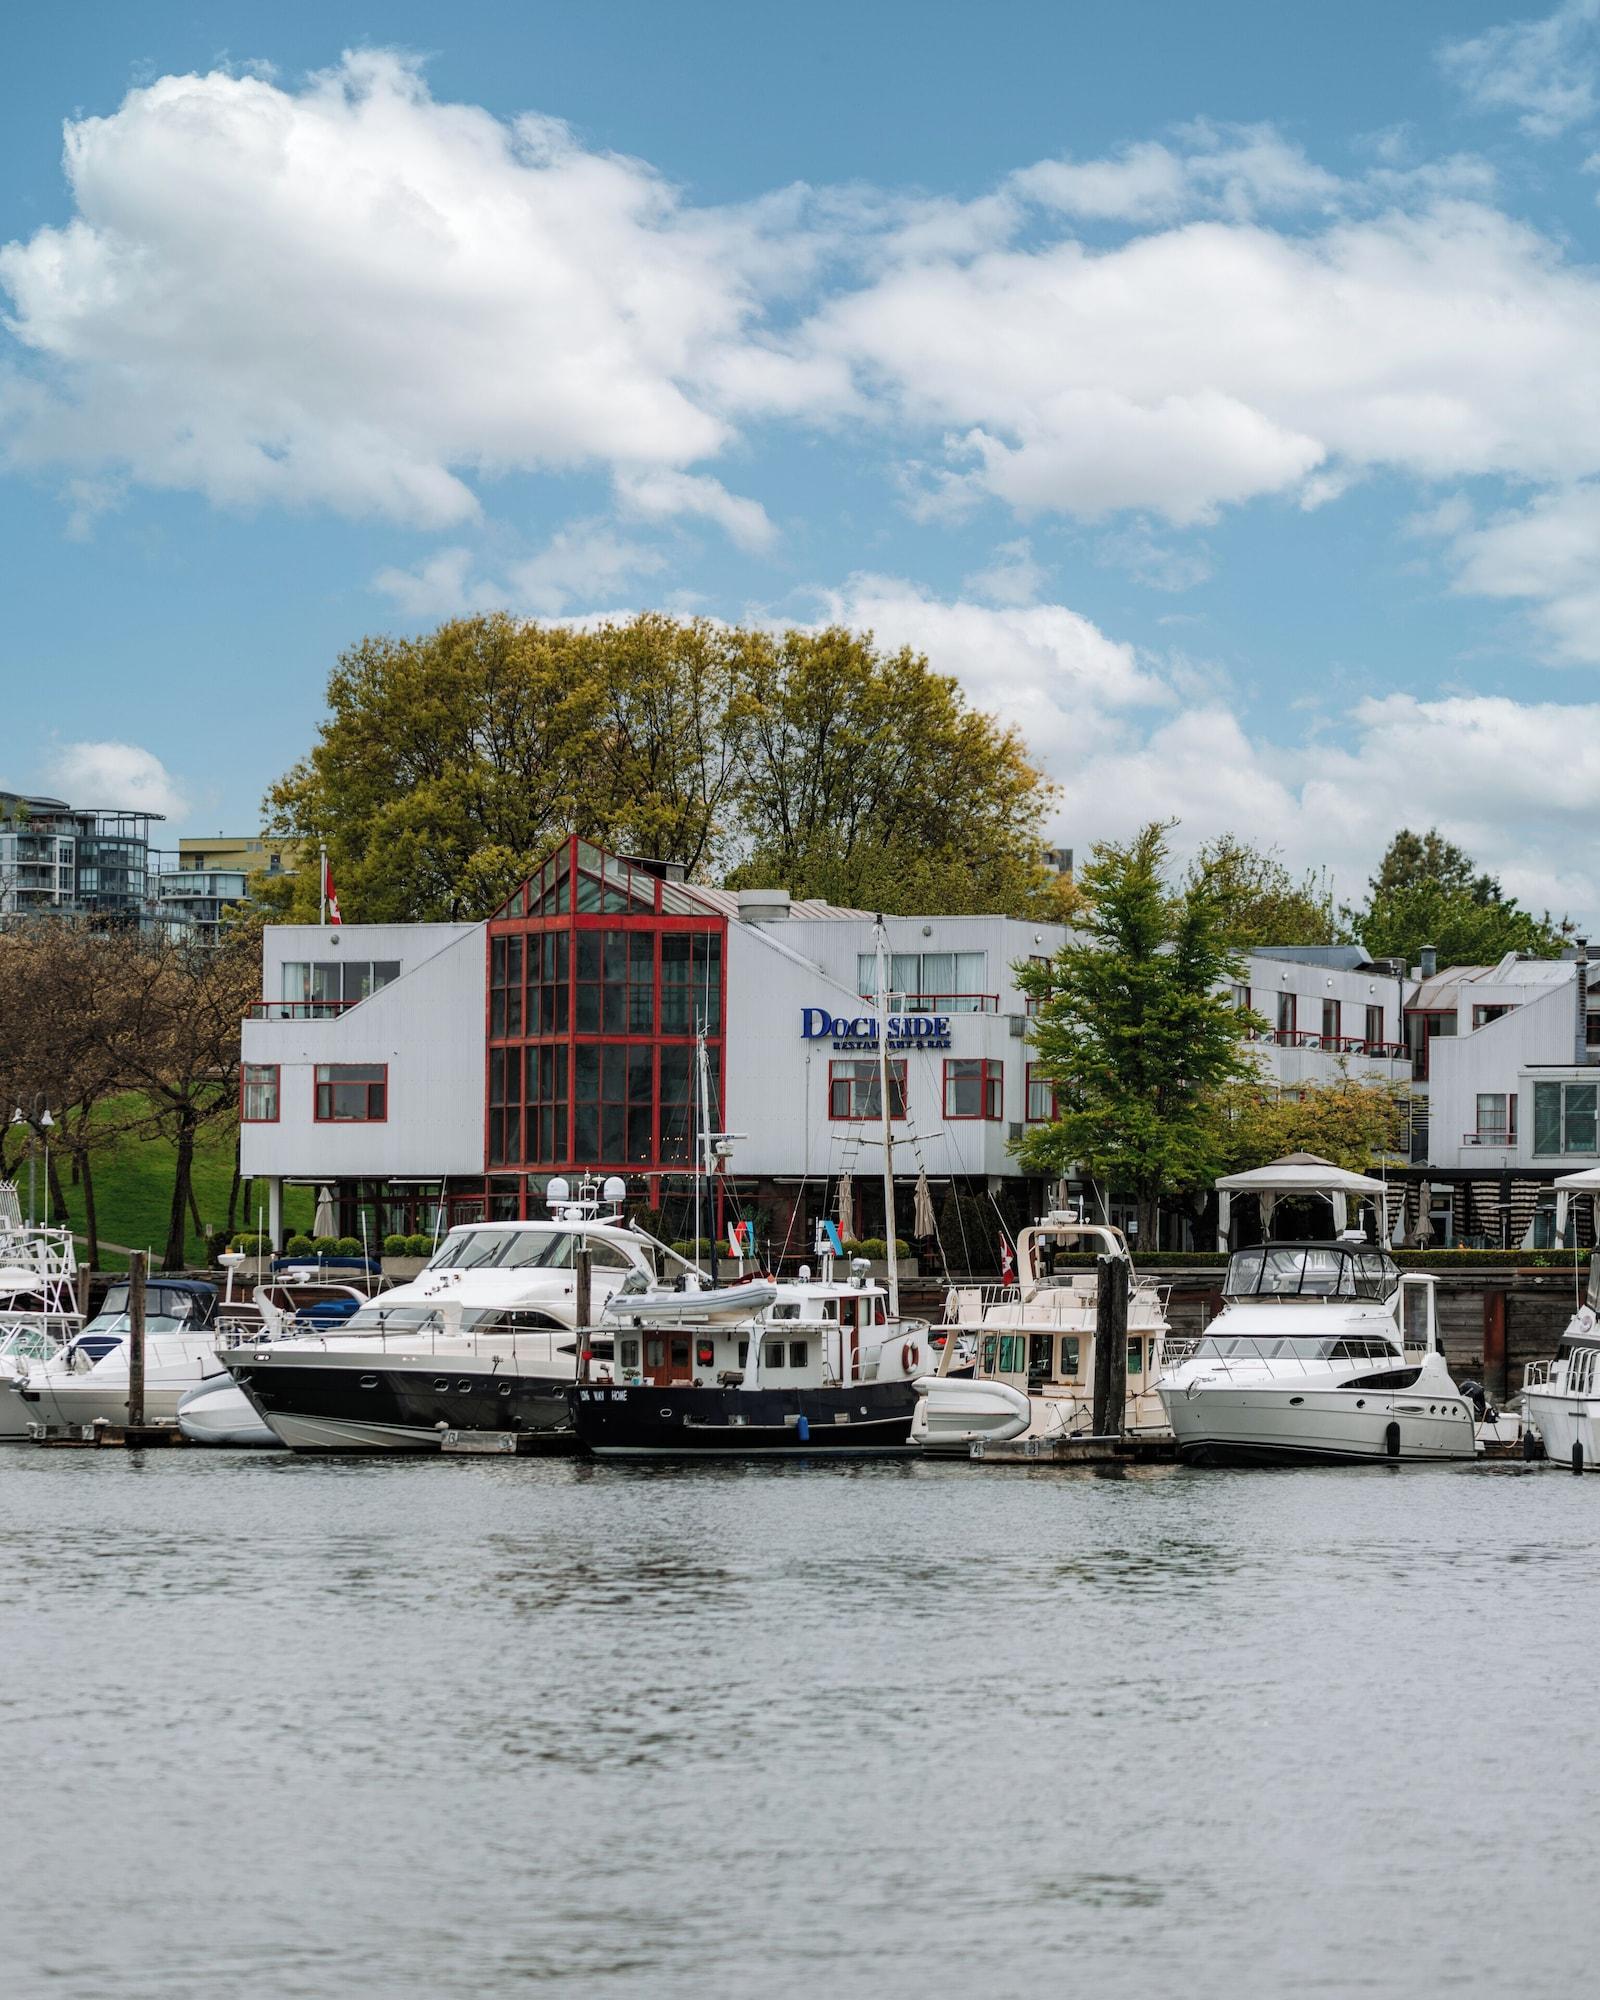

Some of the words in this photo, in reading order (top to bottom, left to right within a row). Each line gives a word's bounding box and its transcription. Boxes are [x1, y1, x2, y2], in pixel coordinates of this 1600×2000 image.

[833, 1041, 912, 1050] RESTAUANT
[927, 1040, 952, 1049] BAR
[611, 1390, 628, 1401] HOME
